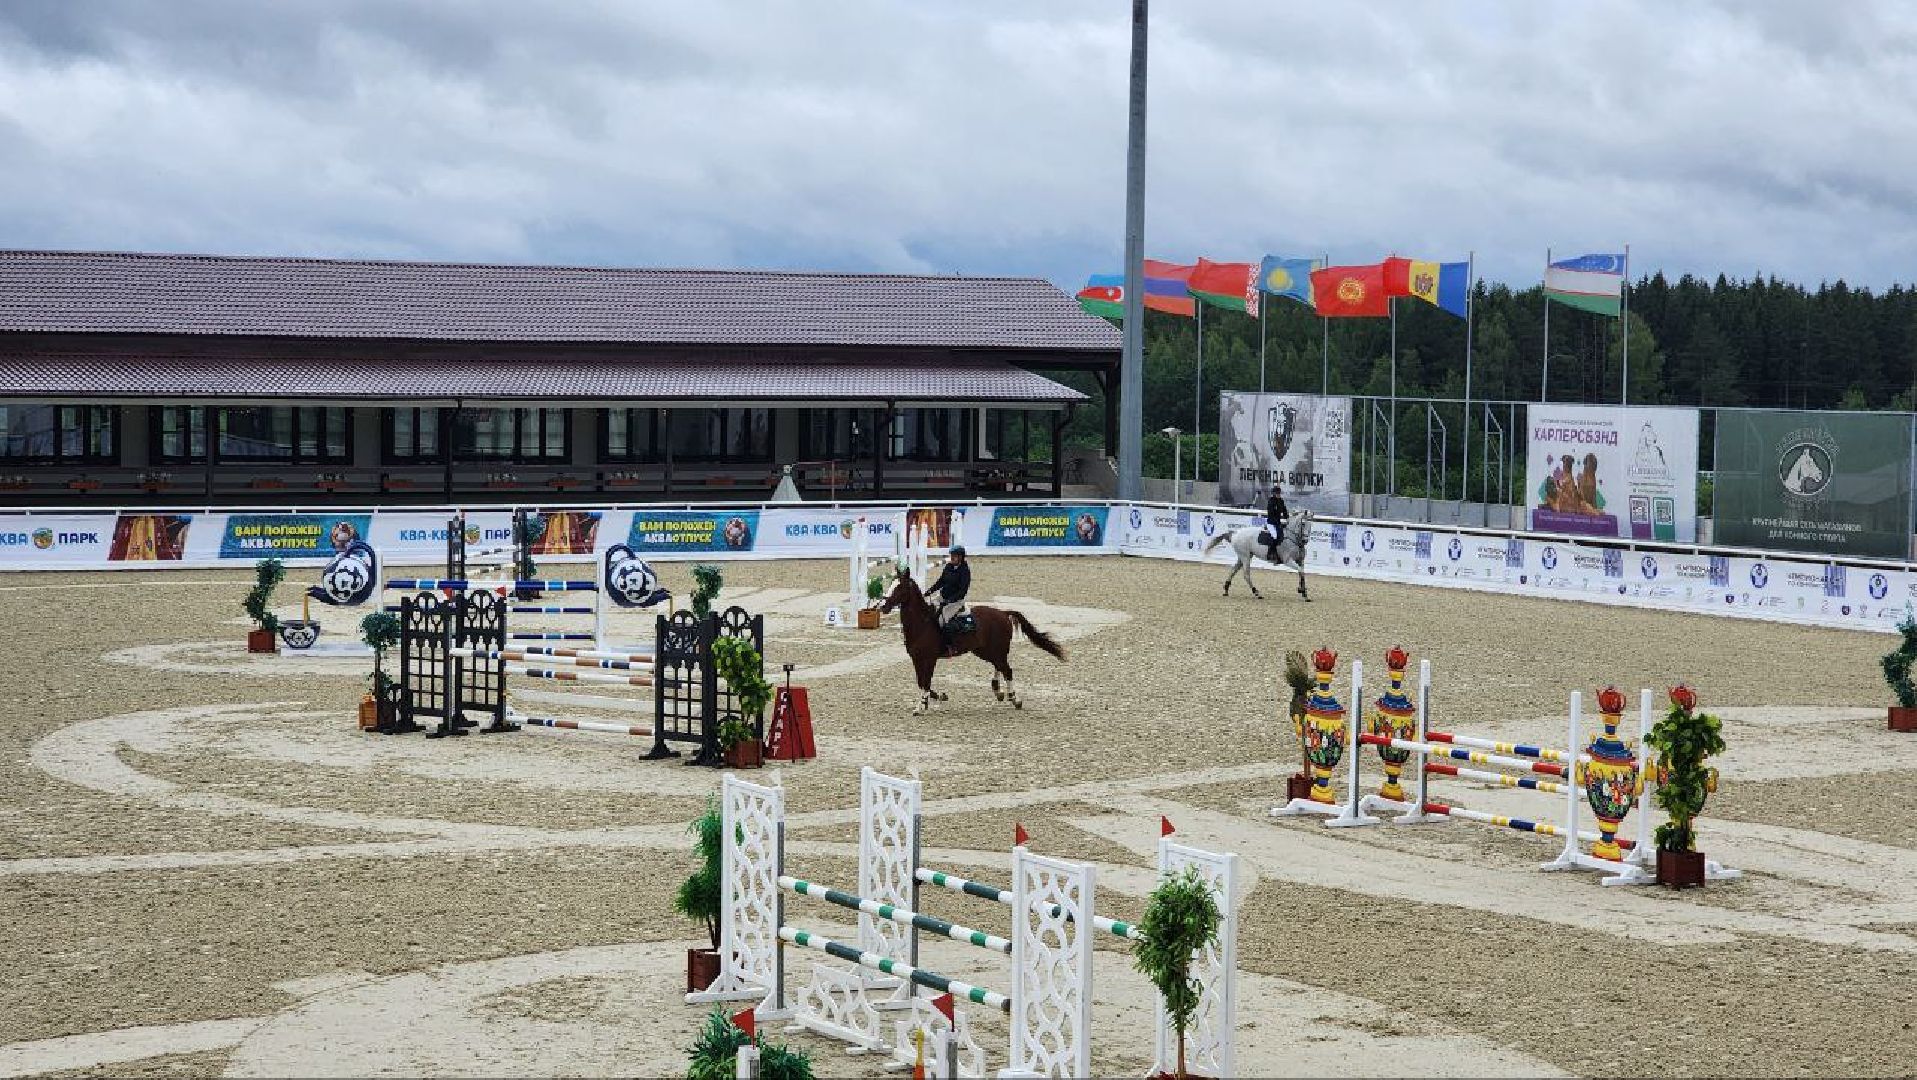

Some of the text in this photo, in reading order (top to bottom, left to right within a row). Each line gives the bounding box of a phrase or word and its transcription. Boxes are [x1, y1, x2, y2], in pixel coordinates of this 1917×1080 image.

[639, 520, 716, 531] ВАМ ПОЛОЖЕН
[999, 516, 1070, 526] ВАМ ПОЛОЖЕН
[235, 525, 322, 536] ВАМ ПОЛОЖЕН
[400, 529, 511, 541] КВА-КВ ПАР
[785, 523, 892, 536] КВА-КВА АРК
[1003, 527, 1065, 537] АКВАОТПУСК
[58, 532, 99, 544] ПАРК
[240, 538, 317, 549] АКВАОТПУСК
[644, 533, 712, 543] АКВАОТПУСК
